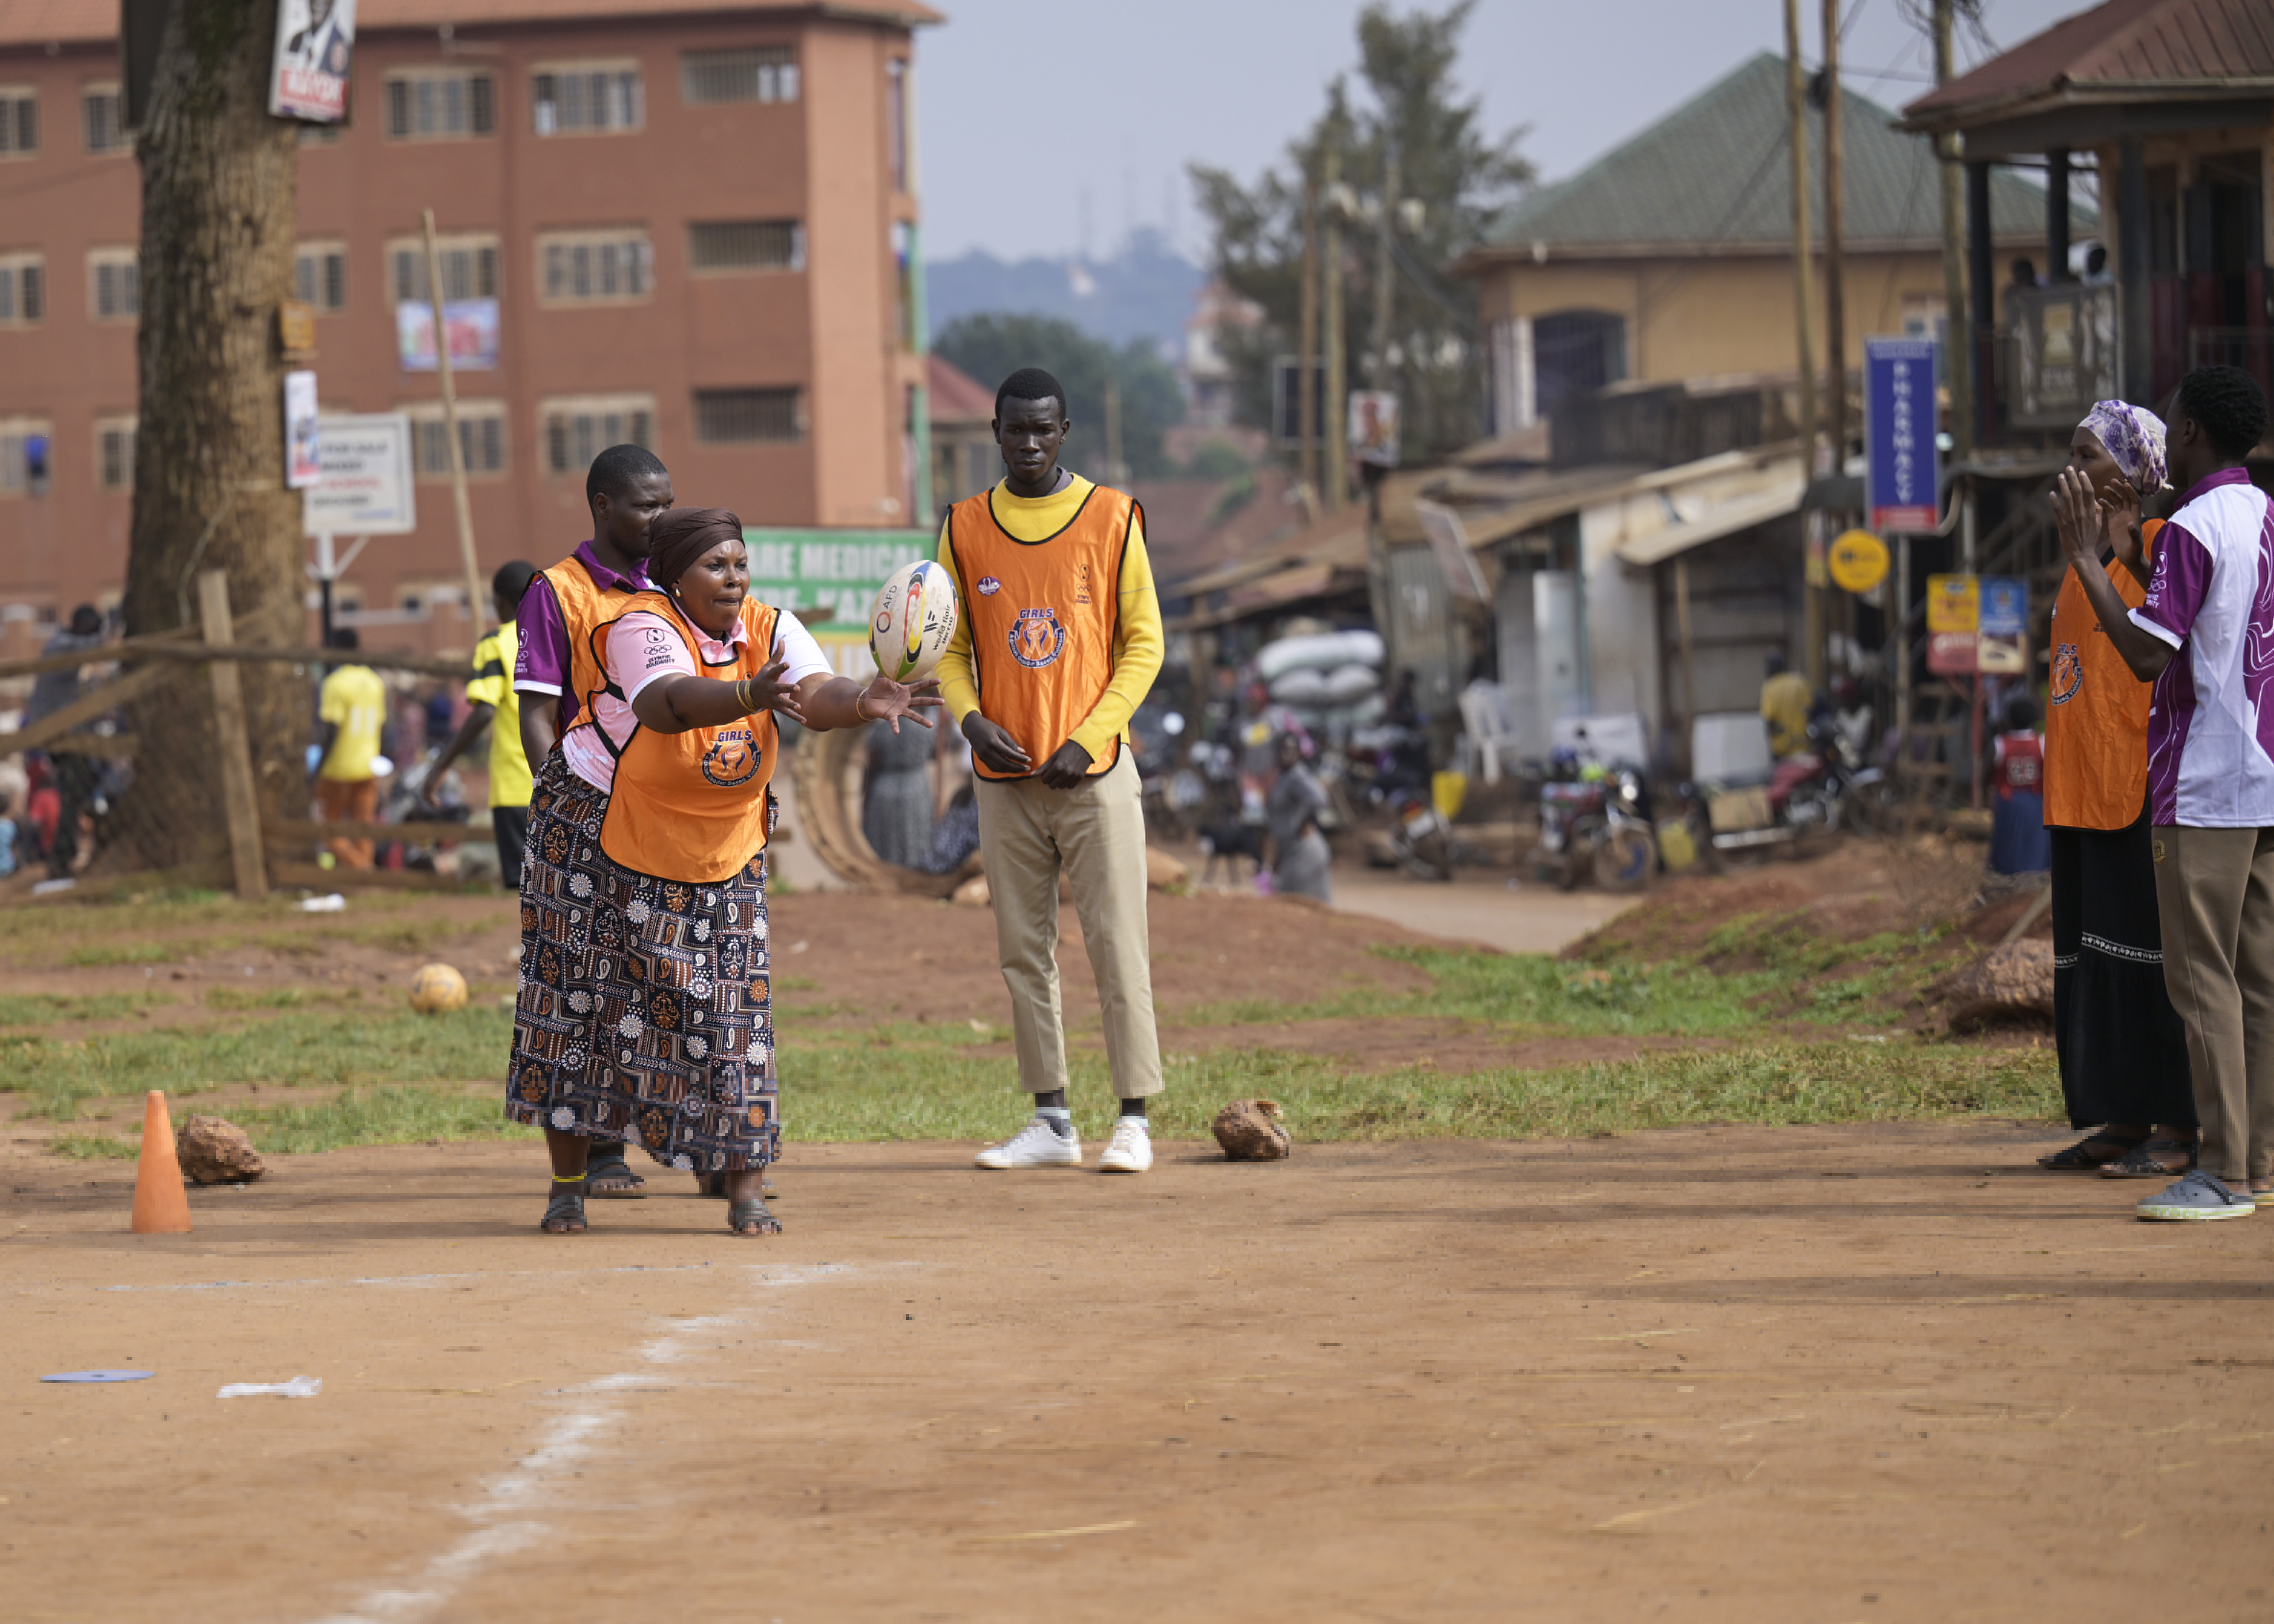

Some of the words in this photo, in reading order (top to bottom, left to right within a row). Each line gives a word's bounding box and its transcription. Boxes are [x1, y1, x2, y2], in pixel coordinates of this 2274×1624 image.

[1893, 360, 1915, 504] PHARMACY
[744, 543, 793, 578] ARE
[883, 584, 898, 609] AFD
[816, 587, 878, 624] KAZ
[1020, 607, 1053, 619] GIRLS
[646, 659, 675, 669] SOLIDARITY
[648, 654, 671, 663] OLYMPIC
[718, 730, 752, 742] GIRLS
[2151, 1206, 2200, 1219] crocs
